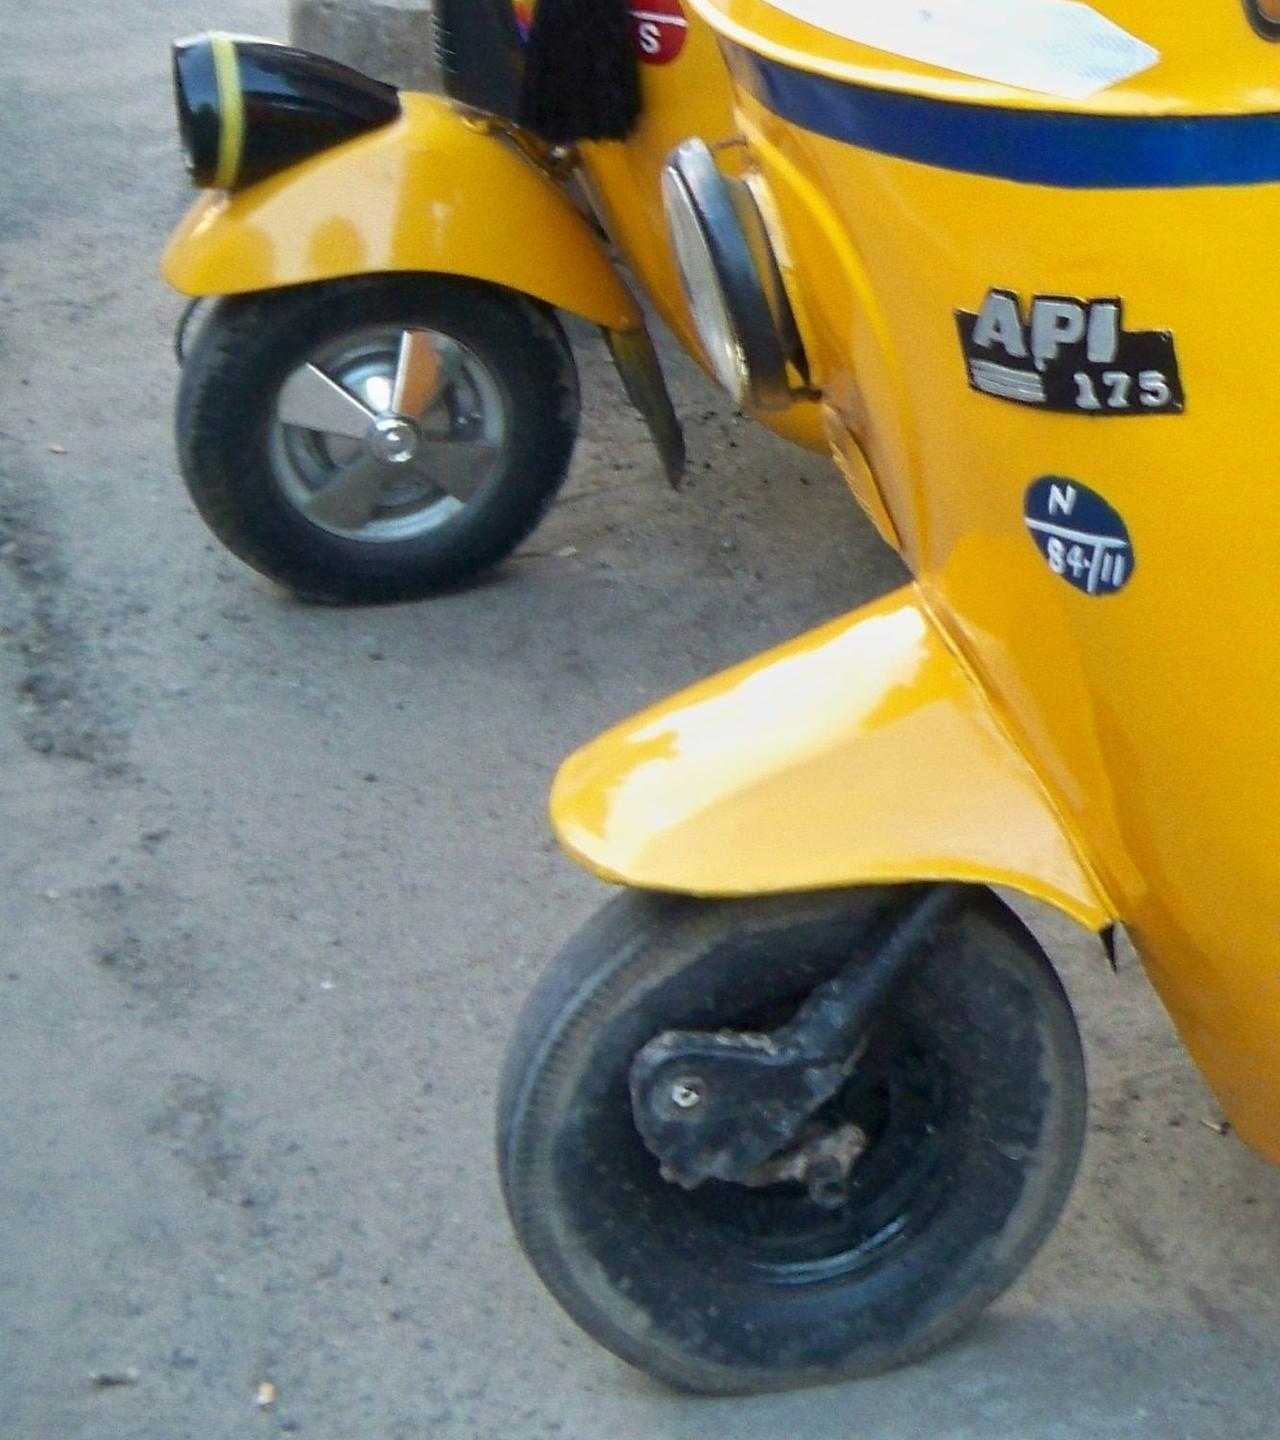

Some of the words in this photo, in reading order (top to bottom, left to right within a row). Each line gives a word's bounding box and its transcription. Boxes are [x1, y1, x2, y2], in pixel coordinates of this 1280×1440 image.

[638, 21, 662, 54] S
[972, 288, 1121, 371] API
[1073, 370, 1172, 410] 175
[1047, 483, 1077, 517] N
